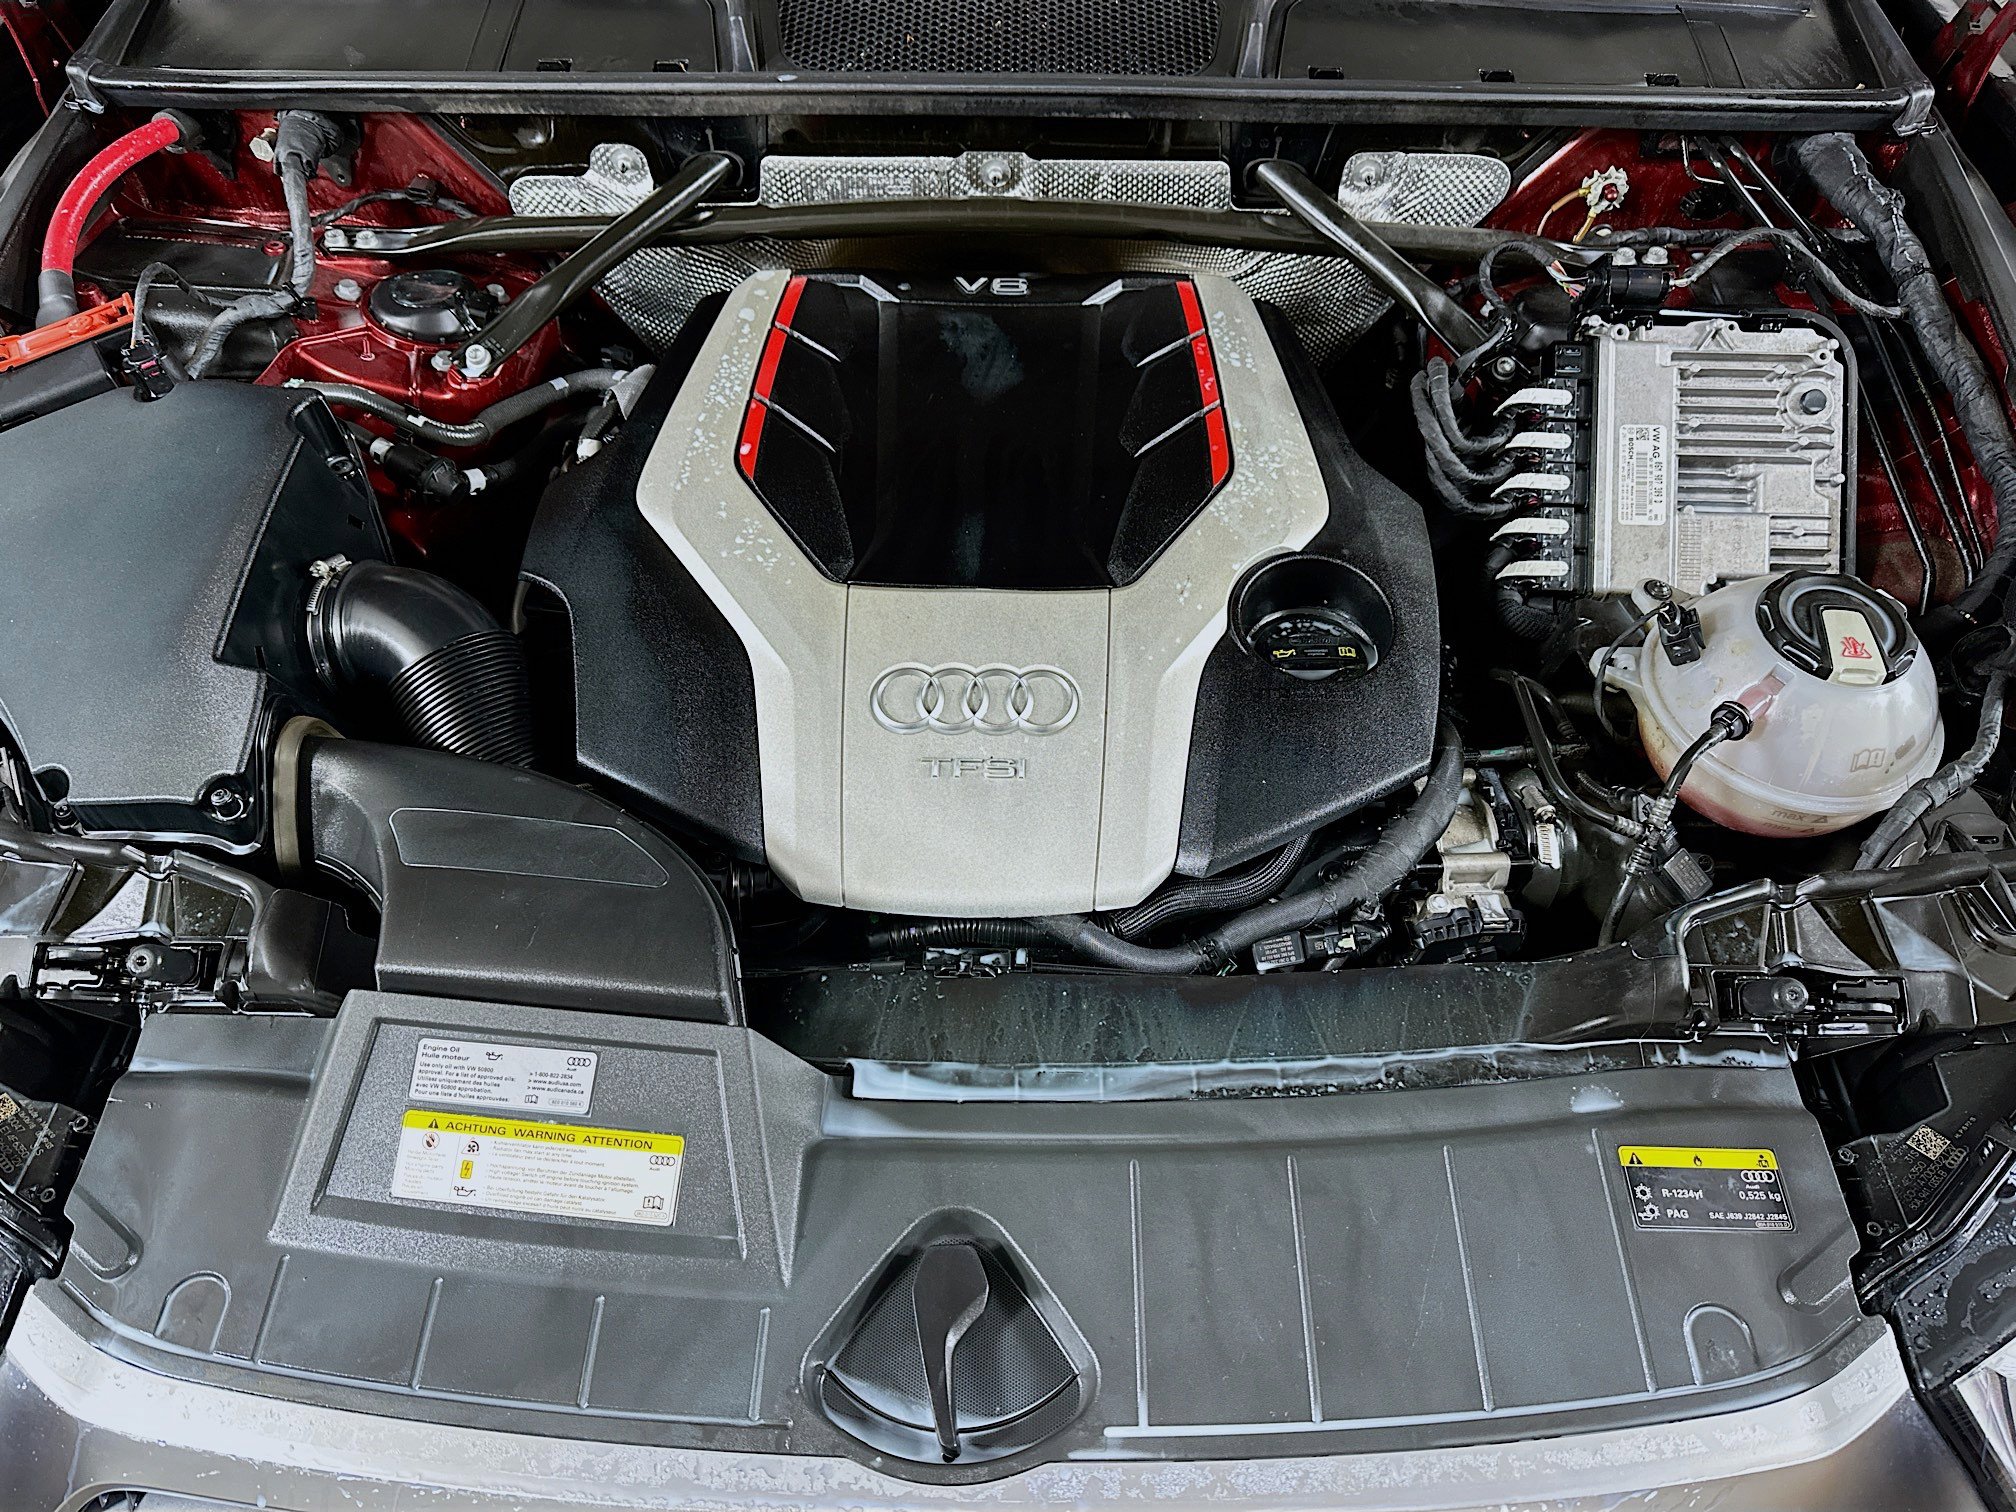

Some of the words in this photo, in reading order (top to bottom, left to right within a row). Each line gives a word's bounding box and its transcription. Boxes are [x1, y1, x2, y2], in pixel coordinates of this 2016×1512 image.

[954, 276, 1029, 295] V6
[1653, 427, 1660, 442] VW
[1653, 445, 1660, 458] AG
[920, 758, 1026, 778] TFSI
[1771, 809, 1805, 823] max
[423, 1044, 448, 1053] Engine
[438, 1078, 472, 1086] uniquement
[533, 1079, 582, 1087] www.audiusa.com
[532, 1086, 584, 1095] www.audicanada.ca
[445, 1121, 506, 1136] ACHTUNG
[513, 1128, 576, 1143] WARNING
[582, 1135, 653, 1150] ATTENTION
[1662, 1189, 1703, 1200] R-1234yf
[1739, 1191, 1766, 1200] 0,525
[1769, 1191, 1781, 1201] kg
[1667, 1209, 1689, 1219] PAG
